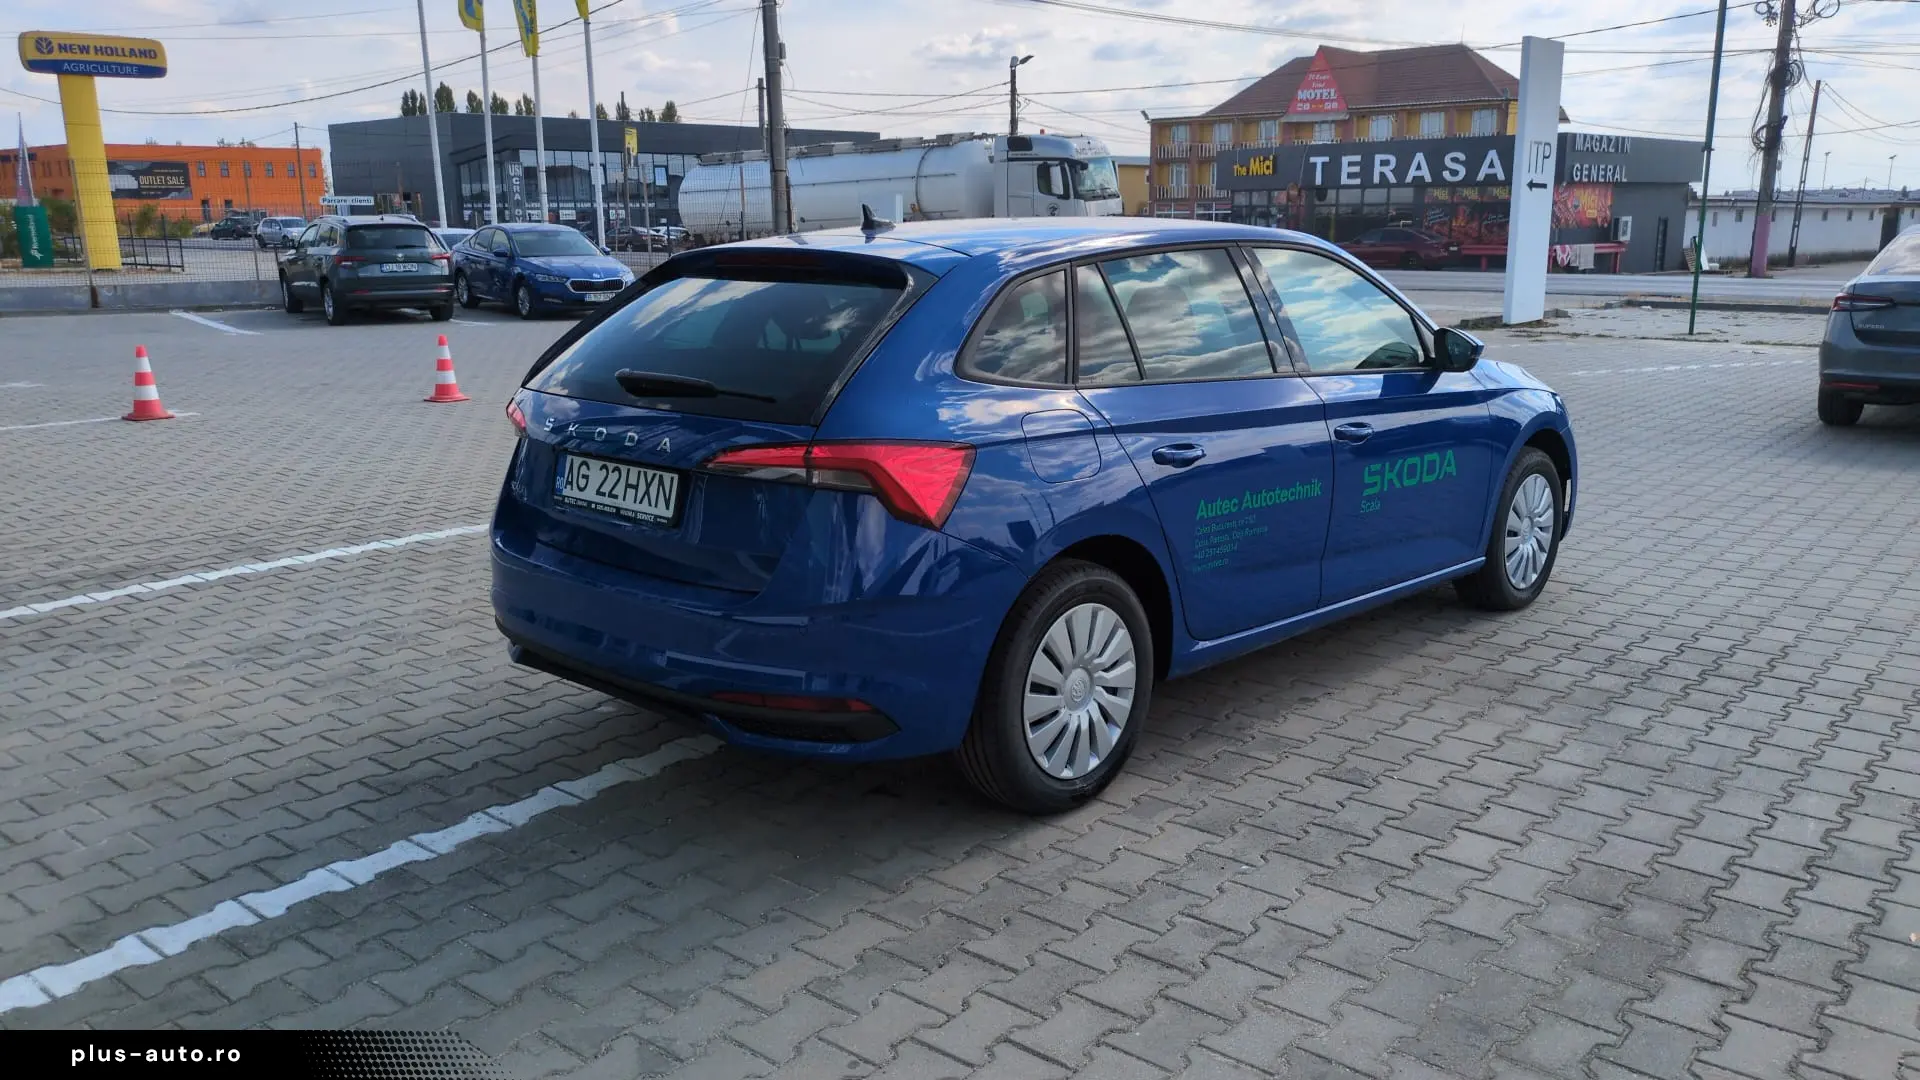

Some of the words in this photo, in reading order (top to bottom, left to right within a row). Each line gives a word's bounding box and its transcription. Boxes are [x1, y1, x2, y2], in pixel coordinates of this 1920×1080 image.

[57, 42, 91, 54] NEW
[94, 45, 158, 59] HOLLAND
[63, 62, 138, 75] AGRICULTURE
[1297, 88, 1337, 101] MOTEL
[1575, 133, 1631, 153] MAGAZIN
[1527, 140, 1552, 175] ITP
[1233, 164, 1247, 176] The
[1309, 149, 1506, 186] TERASA
[1573, 163, 1628, 182] GENERAL
[140, 175, 166, 185] OUTLET
[167, 175, 185, 185] SALE
[564, 457, 590, 494] AG
[595, 465, 676, 511] 22HXN
[1196, 497, 1239, 520] Autec
[1241, 478, 1322, 510] Autotechnik
[1360, 499, 1381, 513] Scala
